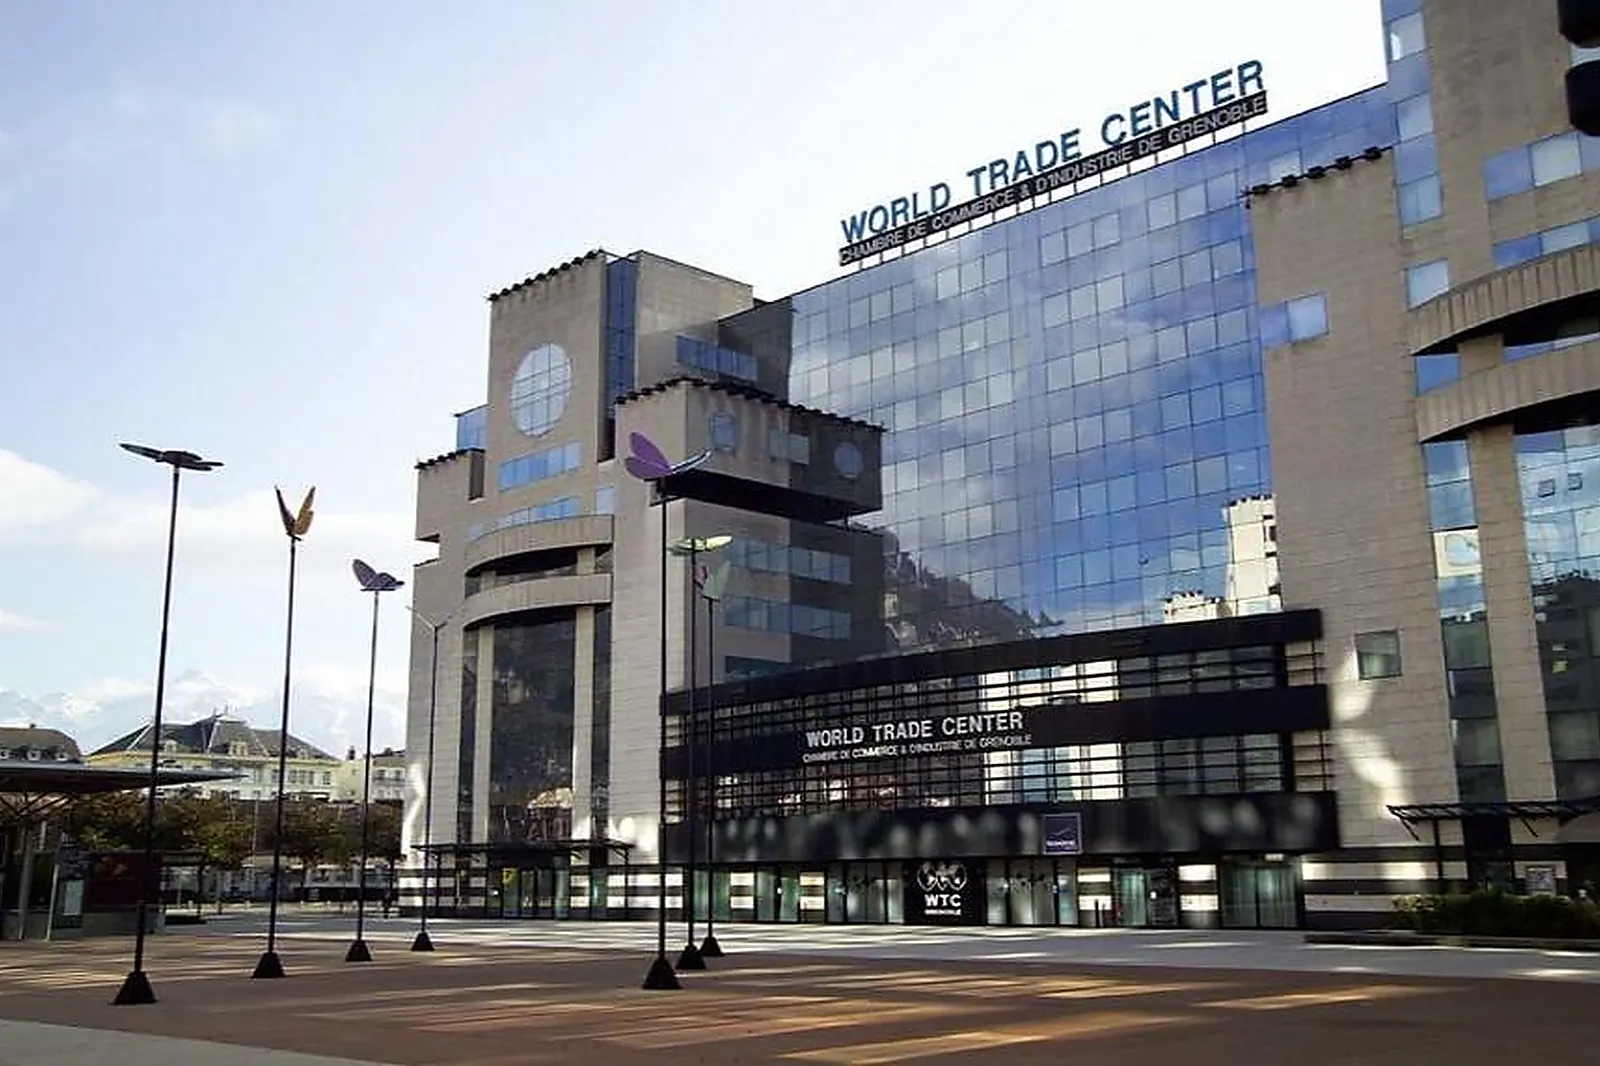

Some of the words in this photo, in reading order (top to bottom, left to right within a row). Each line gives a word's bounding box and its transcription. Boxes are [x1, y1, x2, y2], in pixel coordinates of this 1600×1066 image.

[839, 229, 904, 263] CHAMBRE
[907, 221, 927, 239] DE
[932, 188, 1015, 229] COMMERCE
[1035, 145, 1134, 191] D'INDUSTRIE
[1138, 134, 1163, 155] DE
[1168, 94, 1266, 143] GRENOBLE
[841, 182, 951, 243] WORLD
[966, 128, 1082, 196] TRADE
[1101, 60, 1264, 146] CENTER
[806, 727, 864, 747] WORLD
[872, 720, 933, 742] TRADE
[942, 711, 1023, 735] CENTER
[924, 894, 961, 907] WTC
